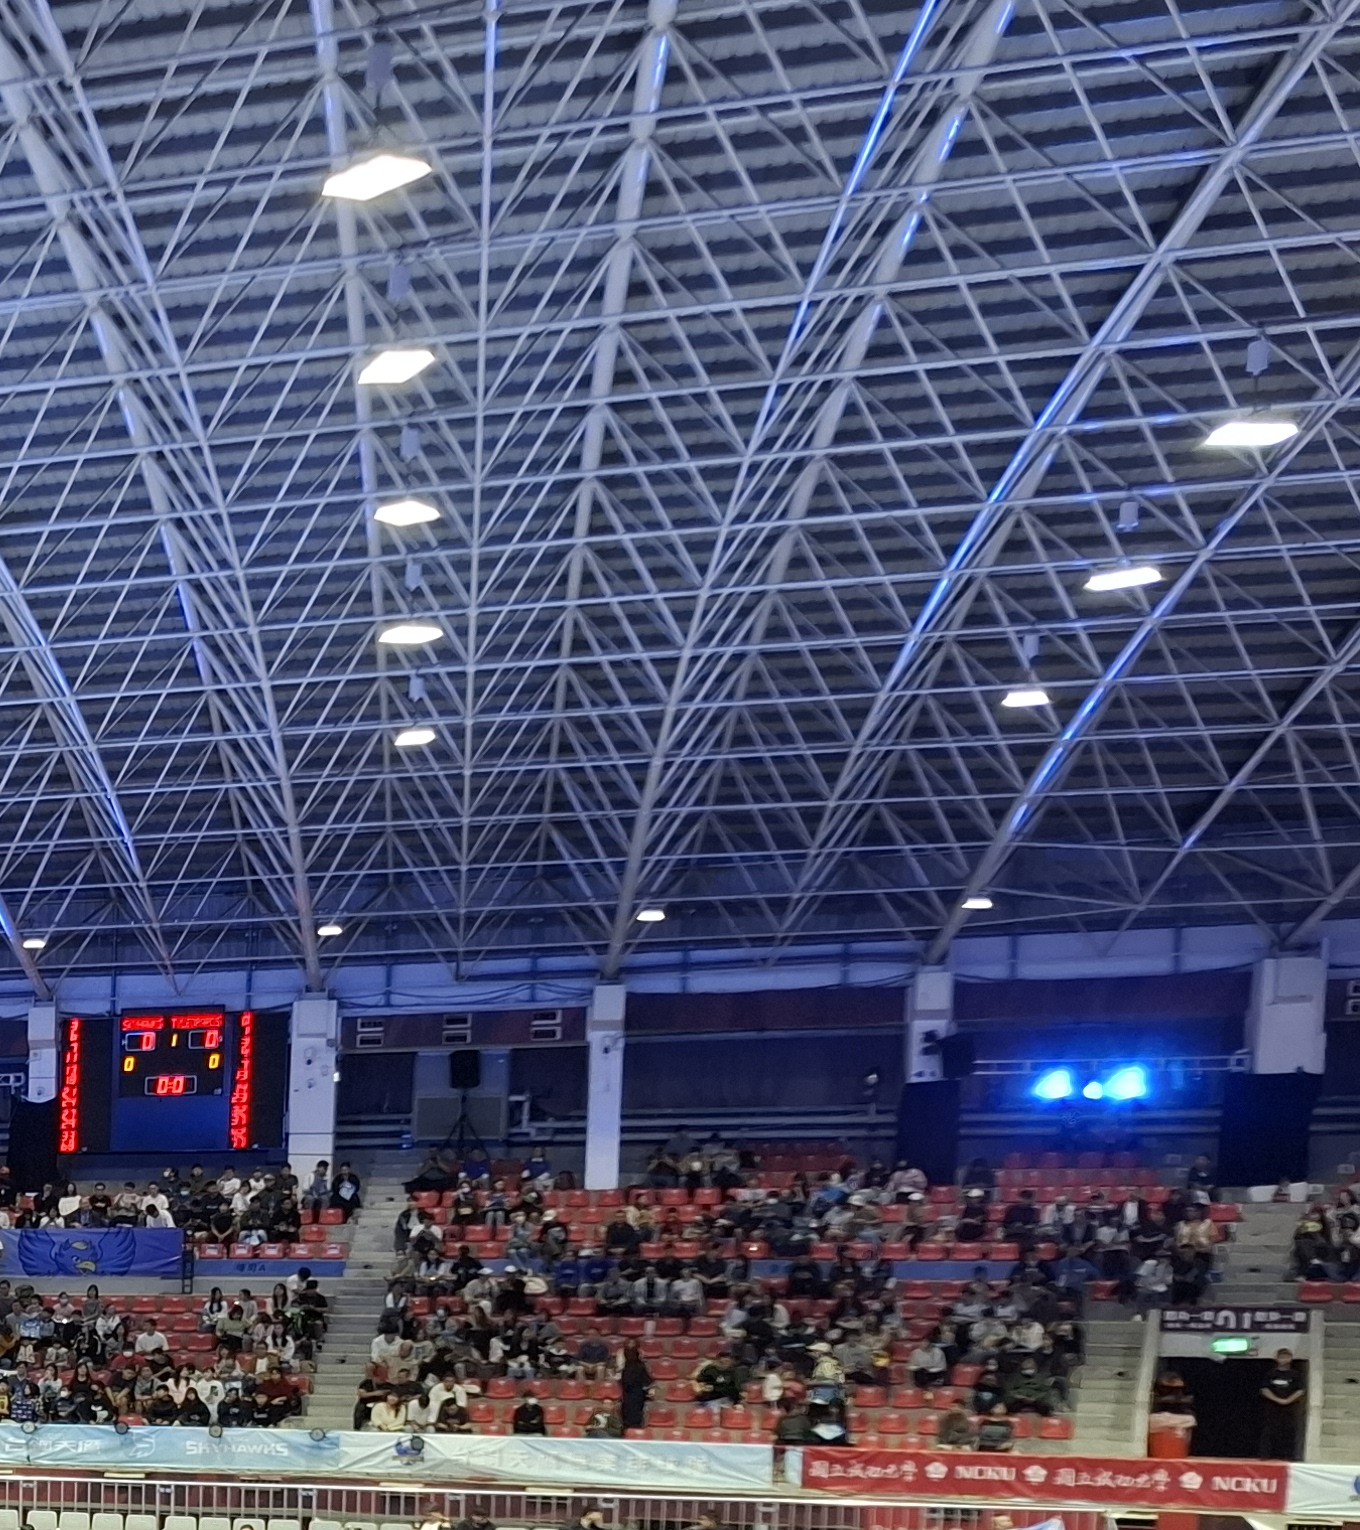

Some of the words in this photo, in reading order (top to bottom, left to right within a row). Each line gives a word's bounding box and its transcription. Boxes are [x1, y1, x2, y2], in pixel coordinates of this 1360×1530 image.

[141, 1032, 155, 1050] 0
[171, 1034, 177, 1047] 1
[205, 1030, 219, 1048] 0
[123, 1056, 135, 1071] 0
[208, 1054, 220, 1069] 0
[185, 1439, 289, 1456] SKYHAWKS
[955, 1465, 1016, 1482] NCKU
[1212, 1476, 1278, 1494] NCKU
